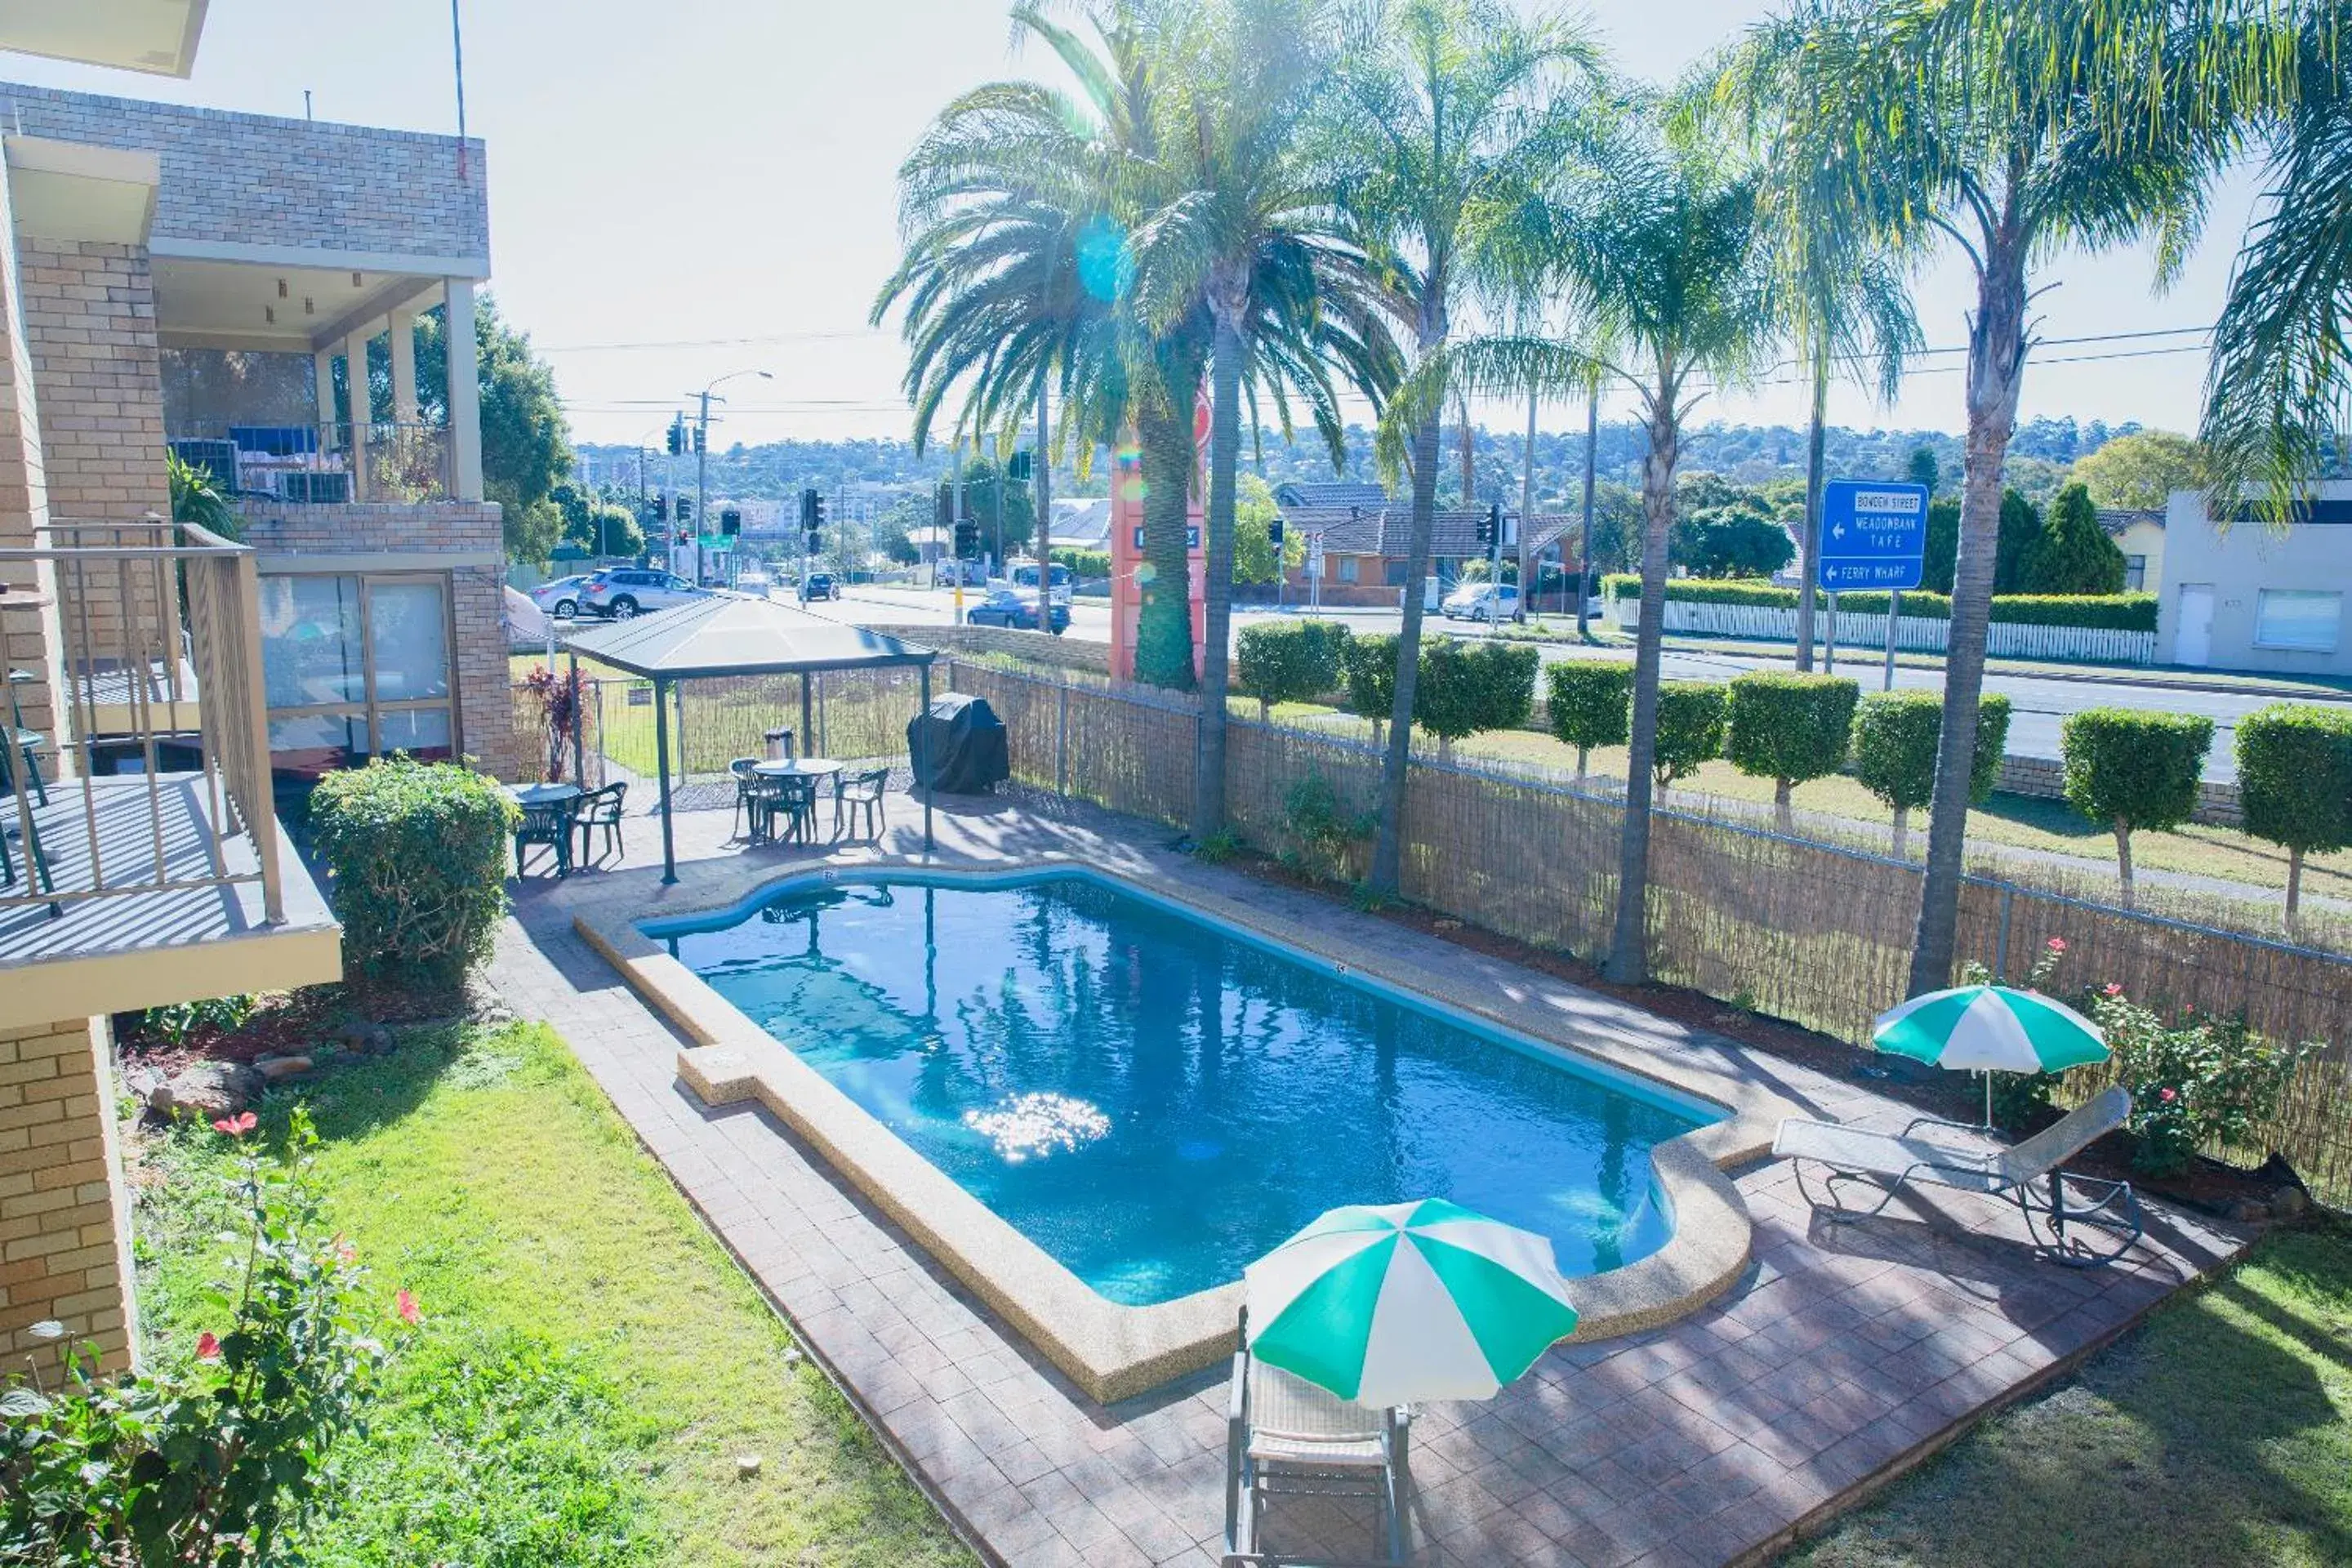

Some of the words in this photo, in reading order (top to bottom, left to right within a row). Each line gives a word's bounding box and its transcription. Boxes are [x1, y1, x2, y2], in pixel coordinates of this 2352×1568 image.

[1891, 497, 1918, 510] STREET
[1871, 534, 1901, 548] TAFE
[1842, 566, 1869, 580] FERRY
